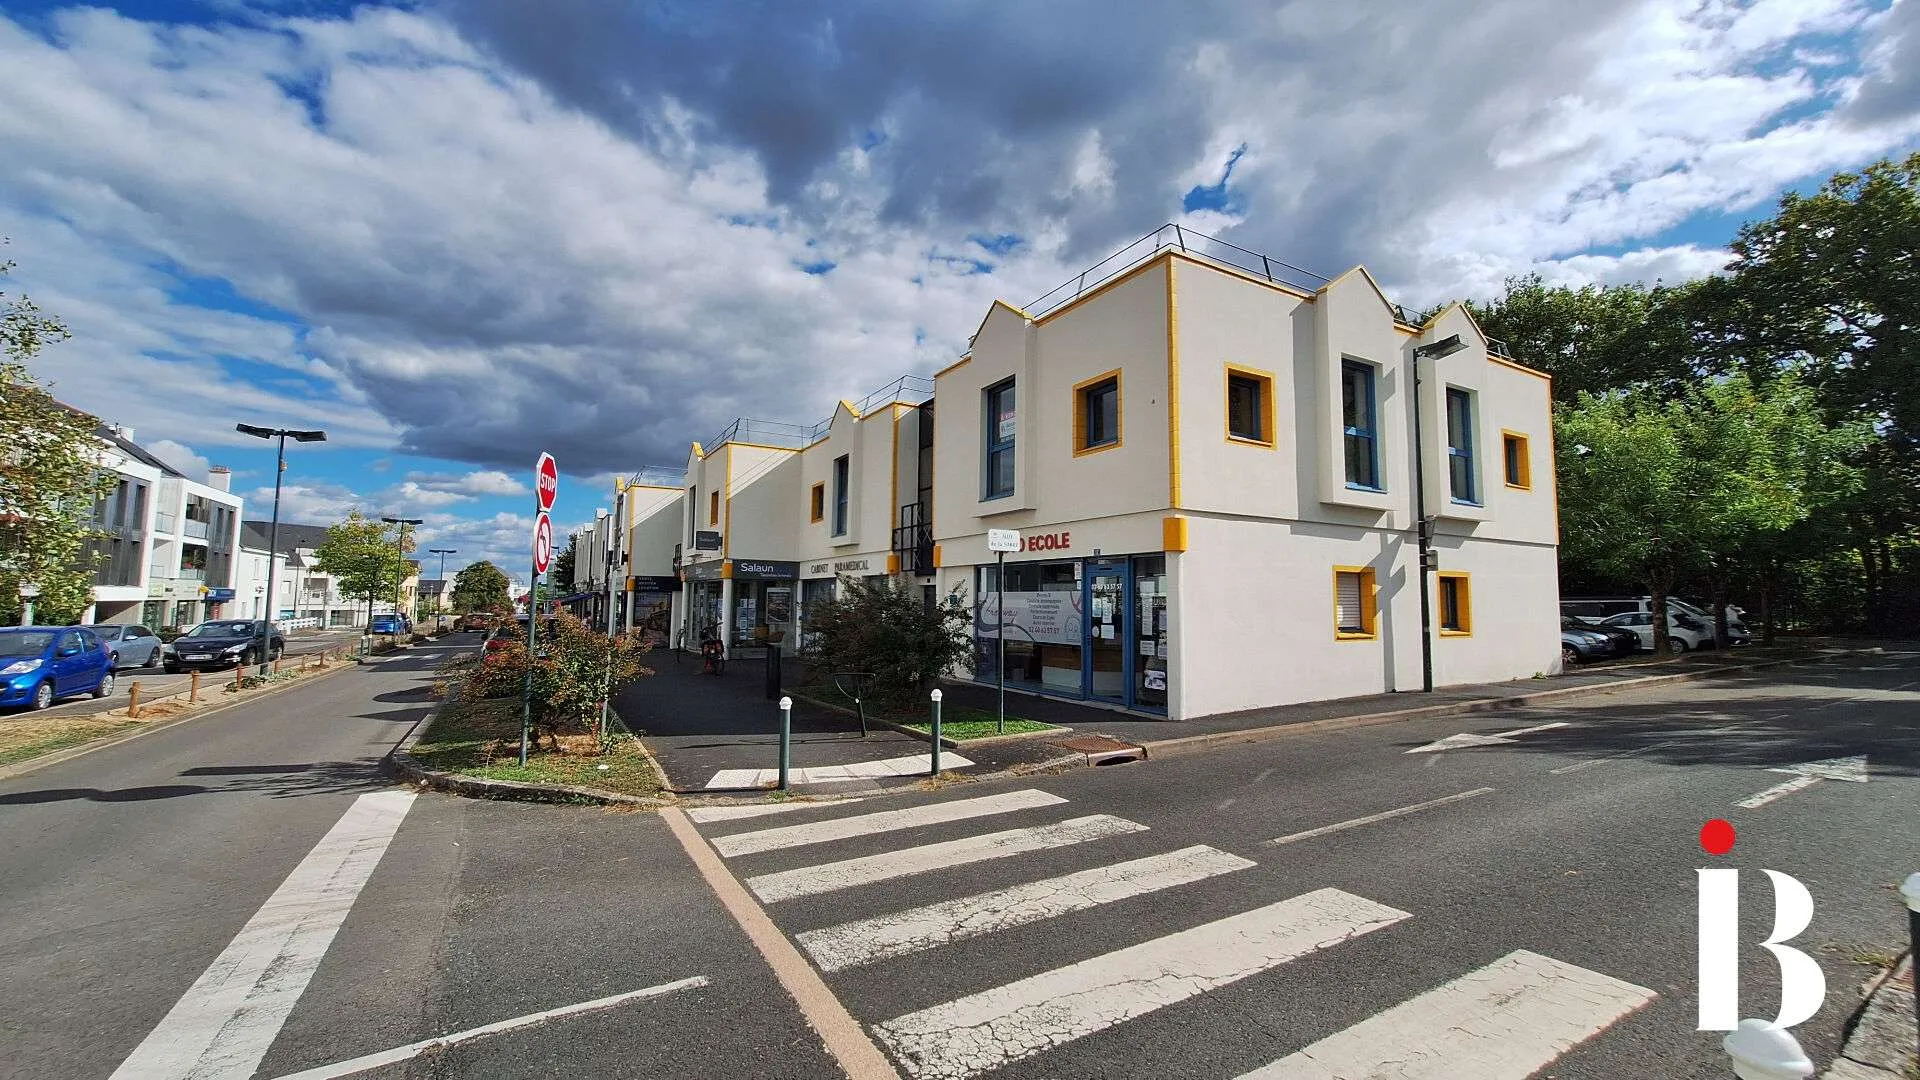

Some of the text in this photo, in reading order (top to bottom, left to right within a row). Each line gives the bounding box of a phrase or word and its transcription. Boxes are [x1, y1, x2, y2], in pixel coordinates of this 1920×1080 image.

[541, 473, 555, 492] STOP
[1028, 532, 1070, 552] ECOLE
[810, 560, 869, 574] CABINET PARAMEDICAL
